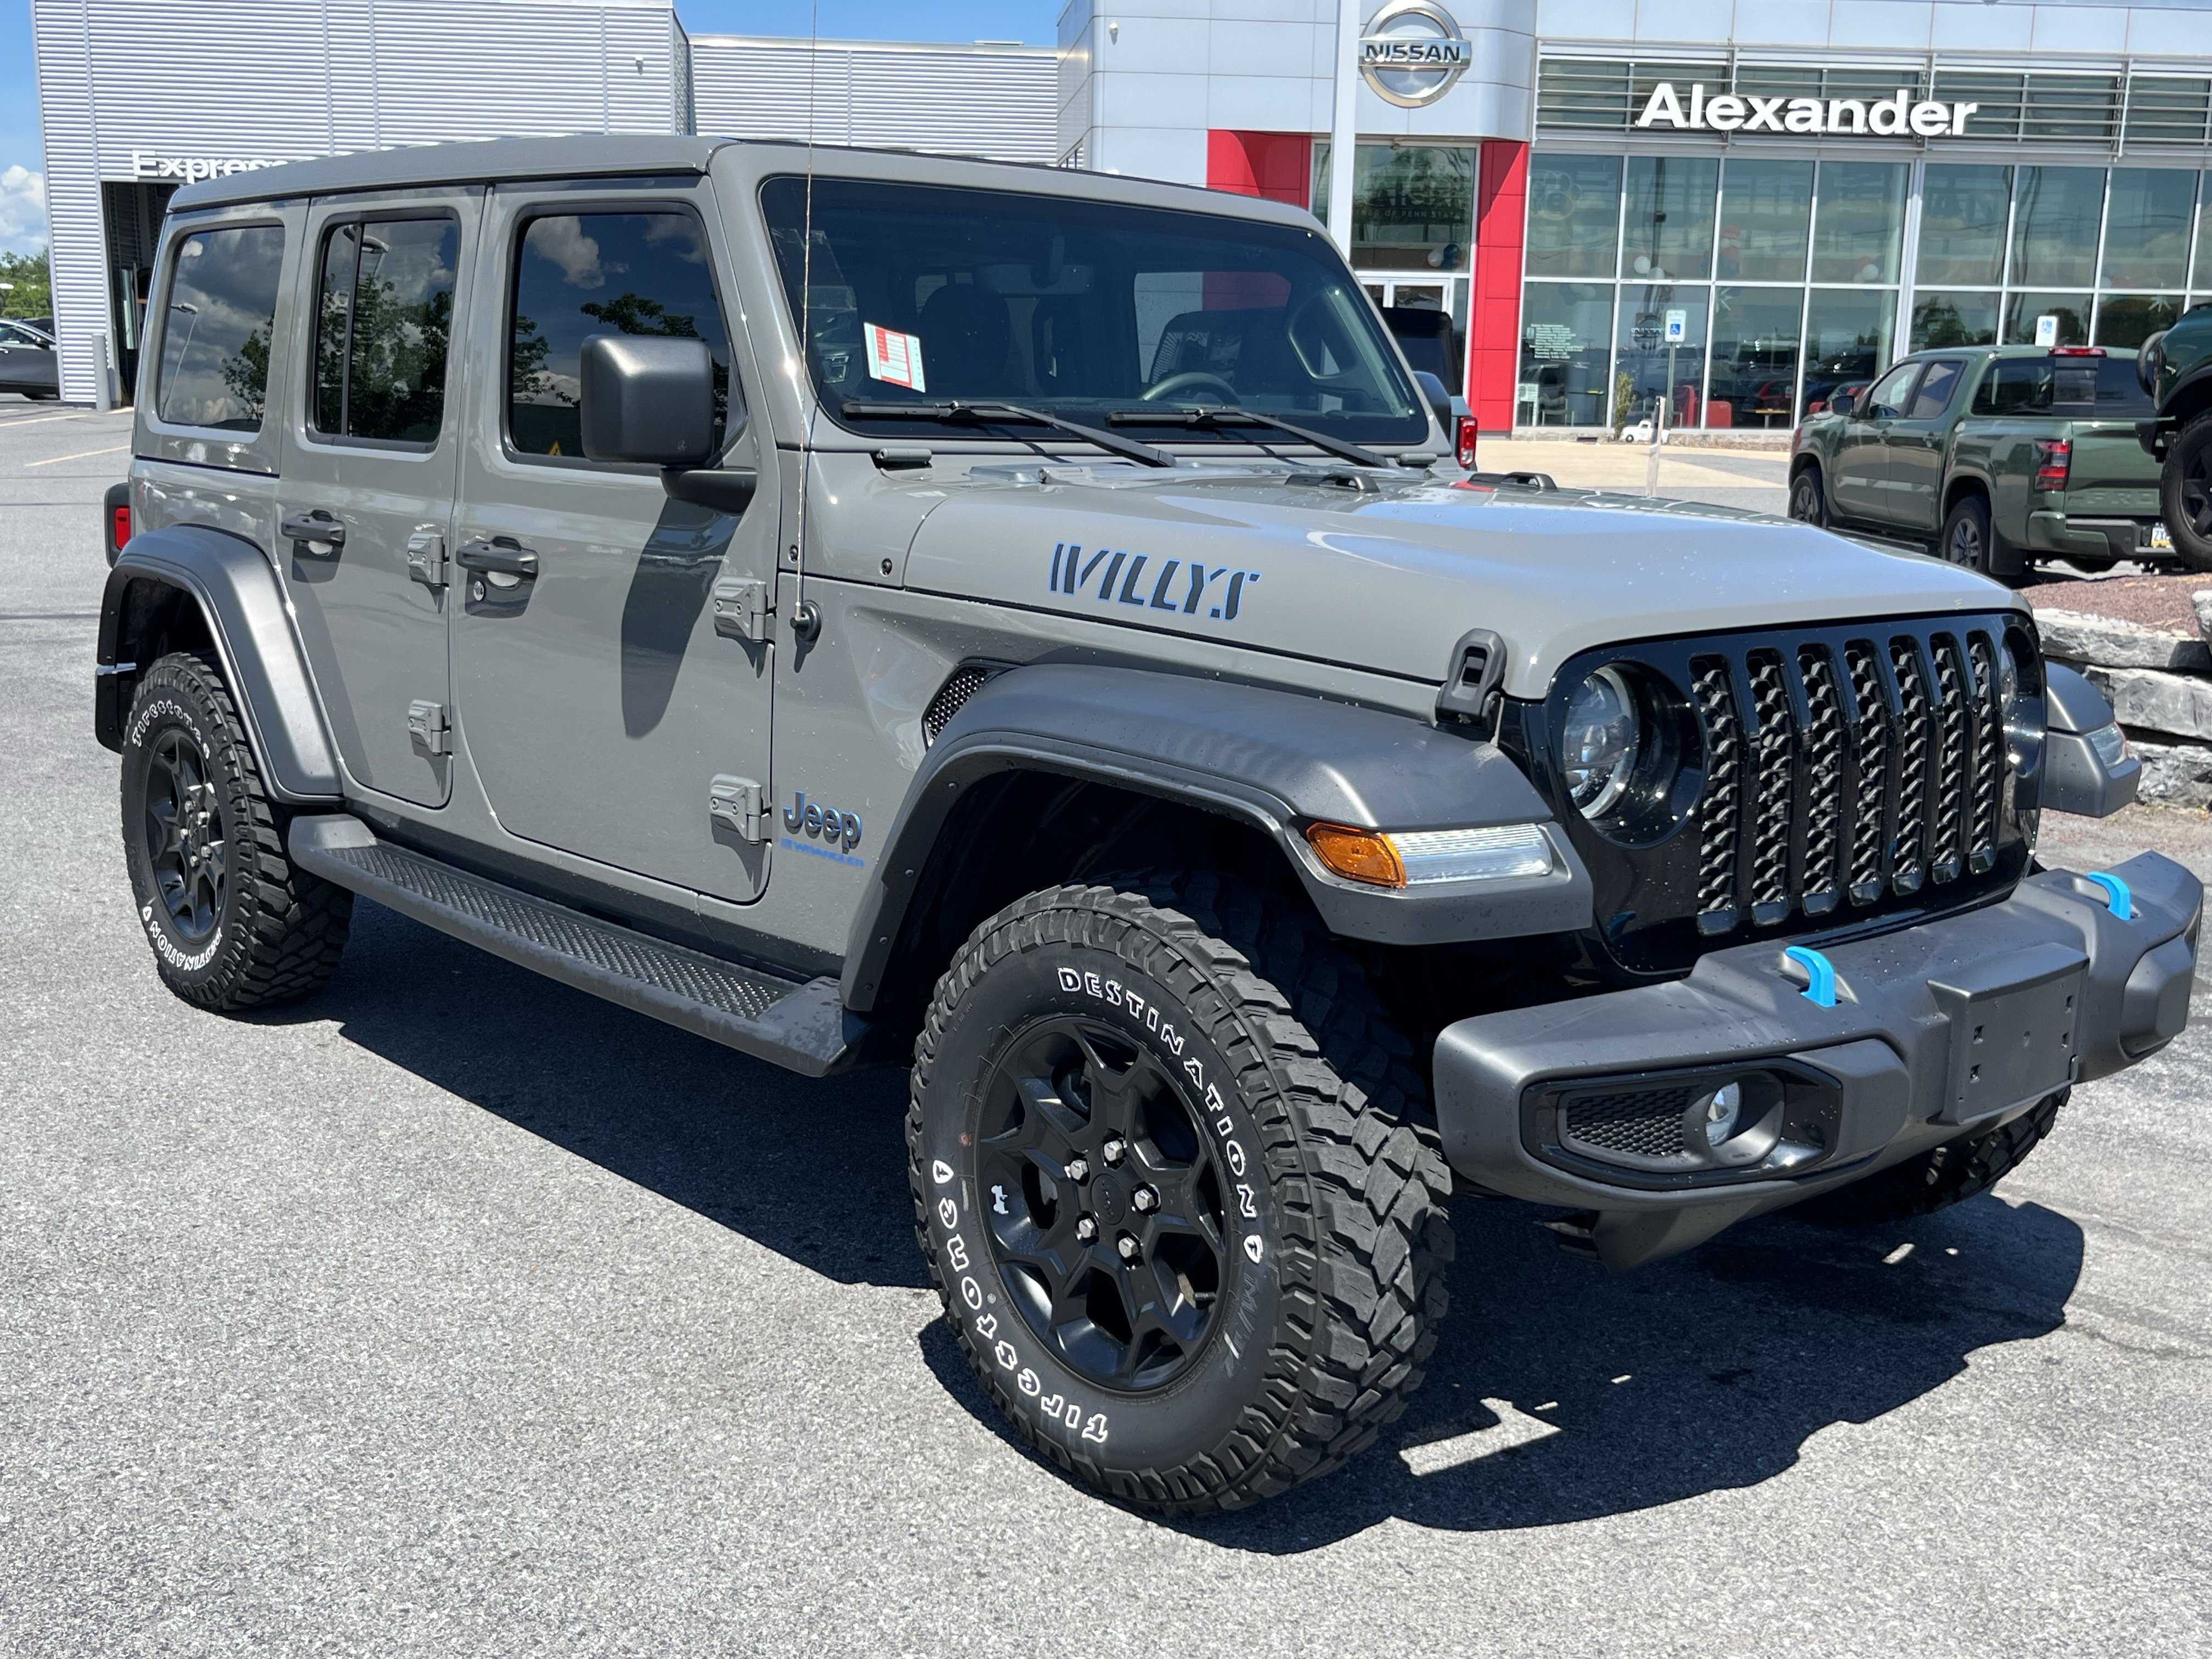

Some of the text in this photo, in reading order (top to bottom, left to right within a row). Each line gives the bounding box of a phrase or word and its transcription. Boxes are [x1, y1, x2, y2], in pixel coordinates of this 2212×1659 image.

[1366, 43, 1460, 62] NISSAN
[1637, 83, 1977, 136] Alexander
[1049, 541, 1262, 620] WILLYS
[132, 699, 202, 747] Firestone
[783, 790, 862, 855] Jeep
[149, 921, 223, 971] DESTINATION
[1057, 967, 1257, 1218] DESTINATION
[938, 1197, 1108, 1443] Firestone
